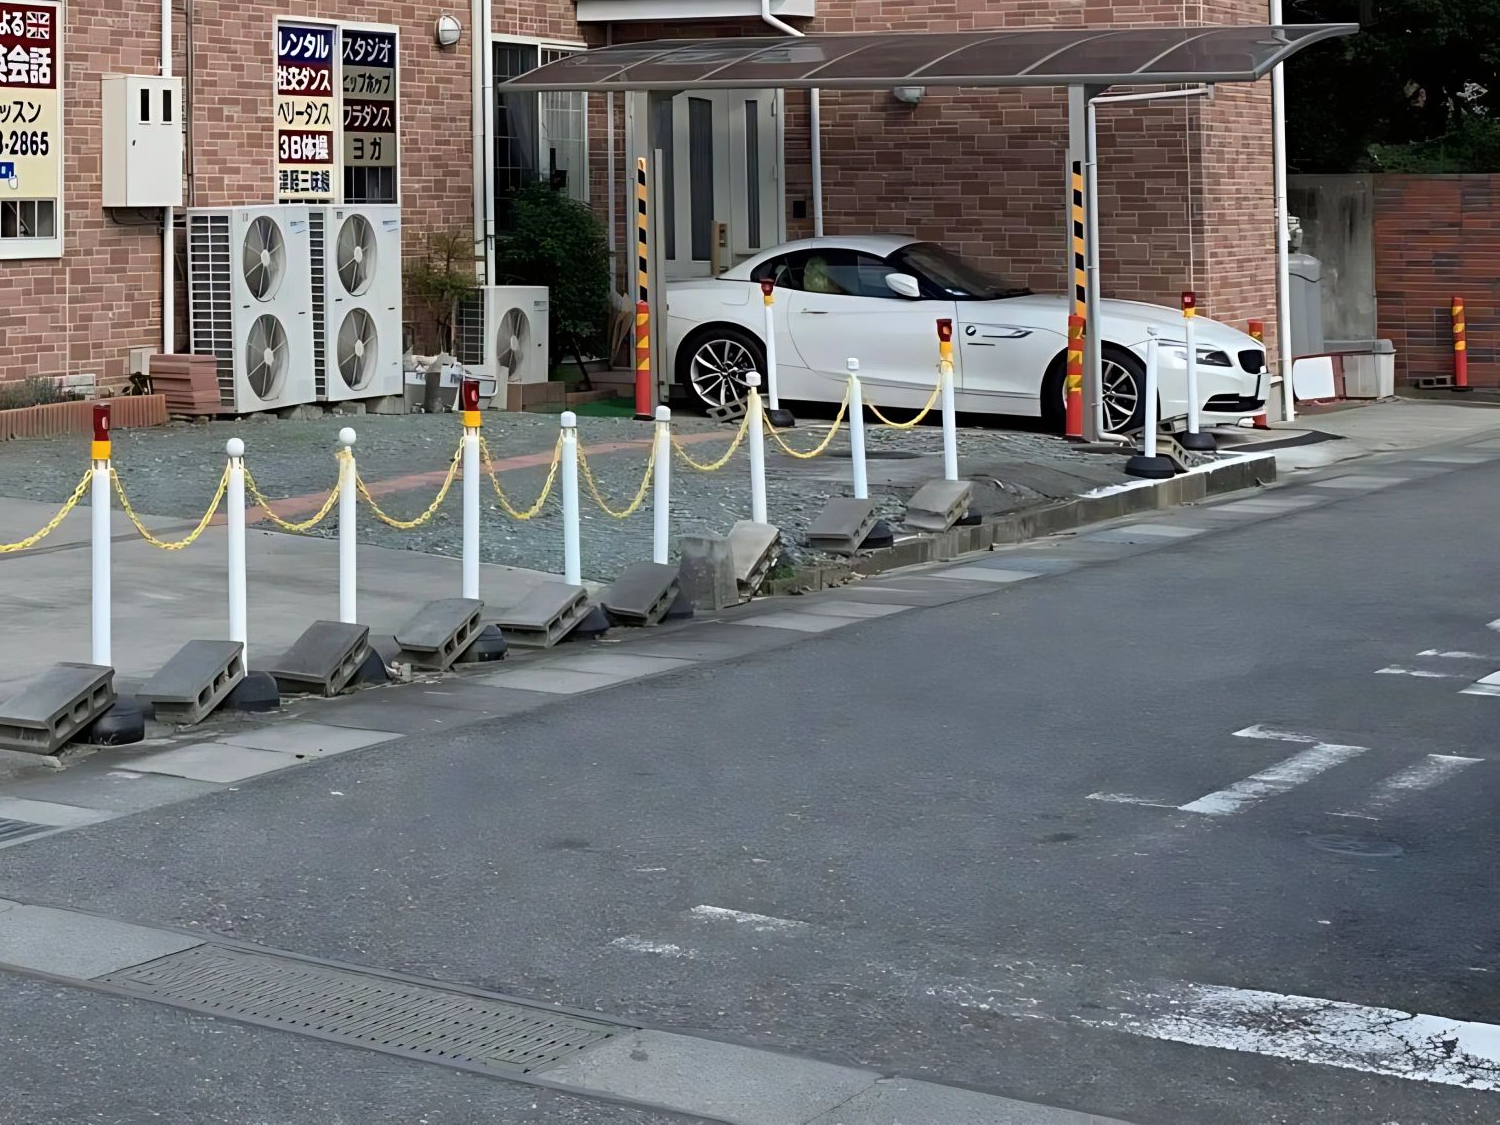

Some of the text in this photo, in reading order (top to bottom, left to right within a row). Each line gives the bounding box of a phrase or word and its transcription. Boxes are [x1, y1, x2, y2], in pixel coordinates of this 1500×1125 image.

[278, 31, 391, 63] レンタル スタジオ
[277, 65, 331, 91] 社交ダンス
[343, 104, 391, 127] フラダンス
[353, 137, 382, 161] ヨガ
